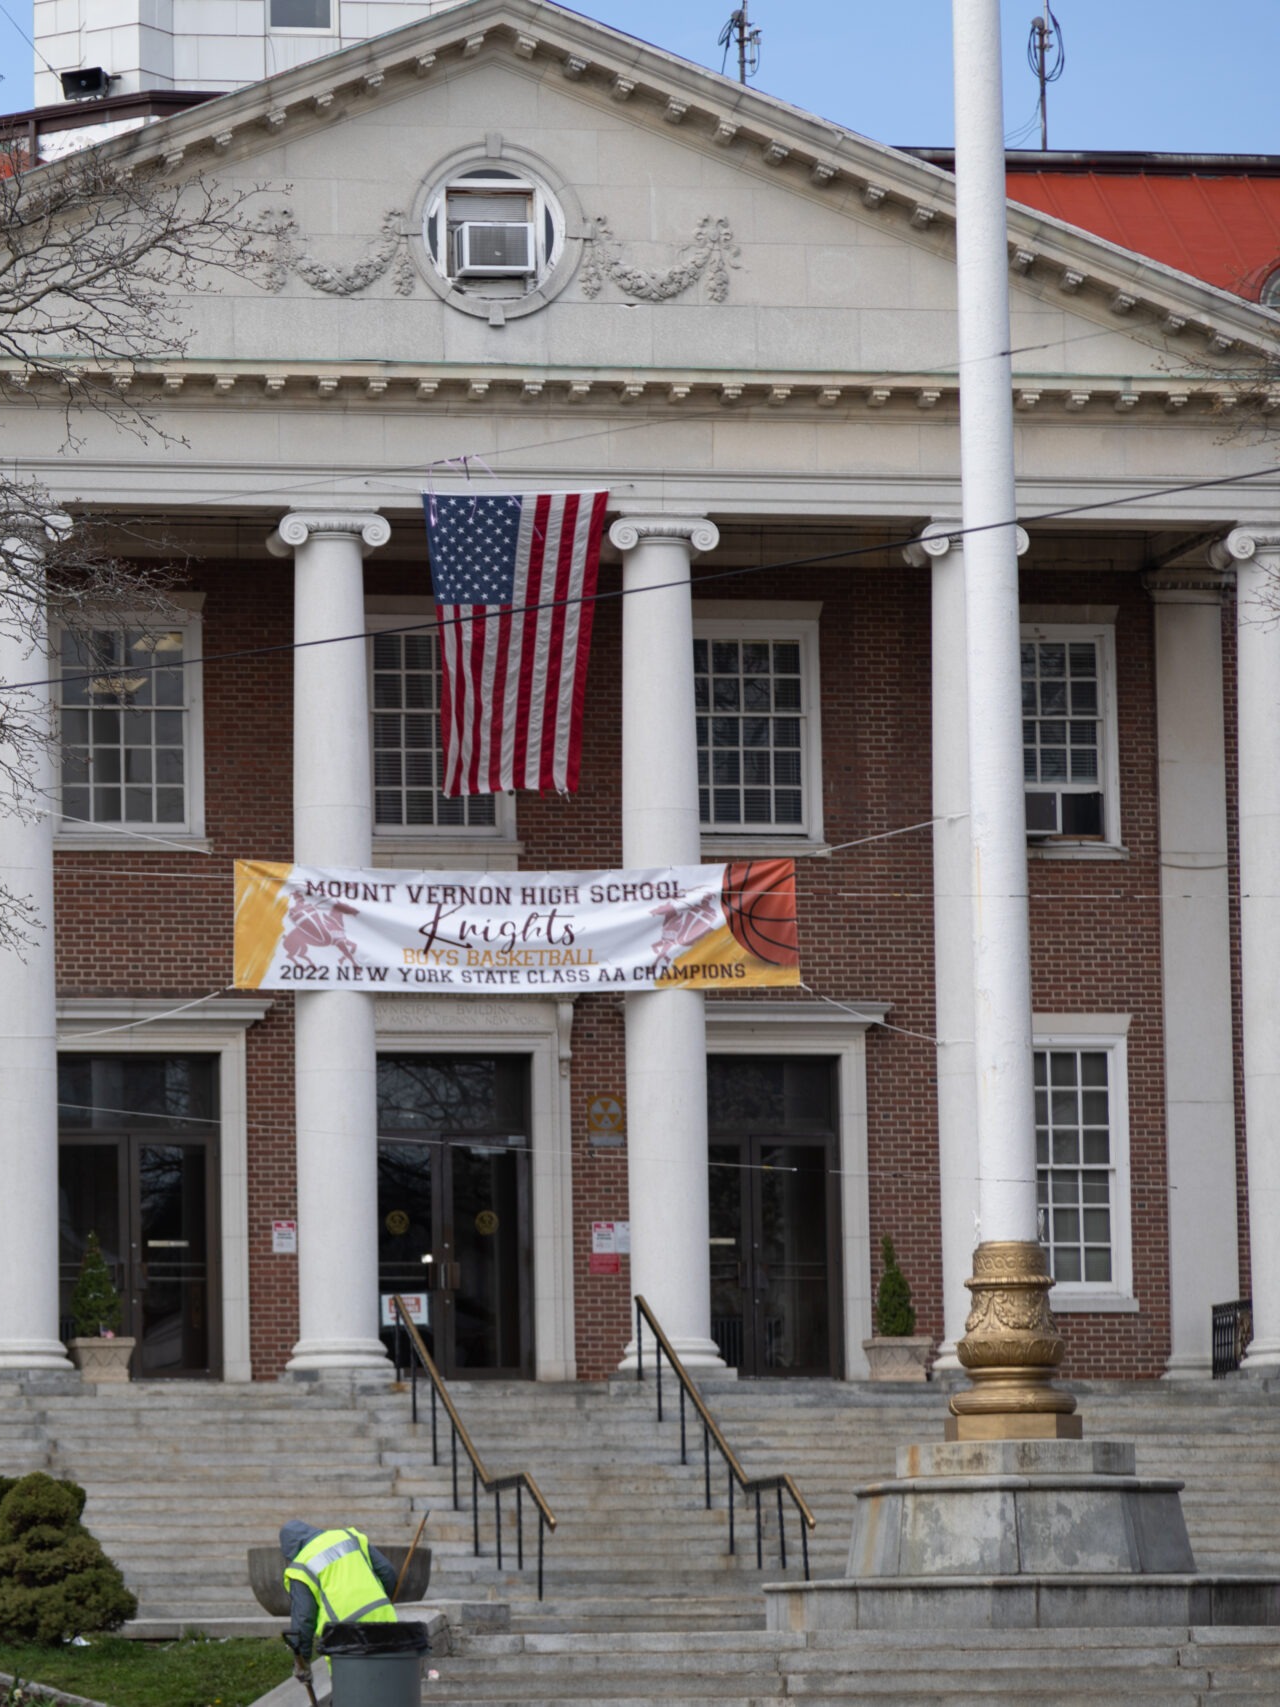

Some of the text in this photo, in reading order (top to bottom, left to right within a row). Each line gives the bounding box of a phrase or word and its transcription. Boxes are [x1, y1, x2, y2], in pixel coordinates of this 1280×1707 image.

[305, 880, 686, 906] MOUNT VERNON HIGH SCHOOL
[418, 885, 582, 955] Knights
[402, 947, 599, 968] BOYS BASKETBALL
[279, 962, 747, 985] 2022 NEW YORK STATE CLASS AA CHAMPIONS
